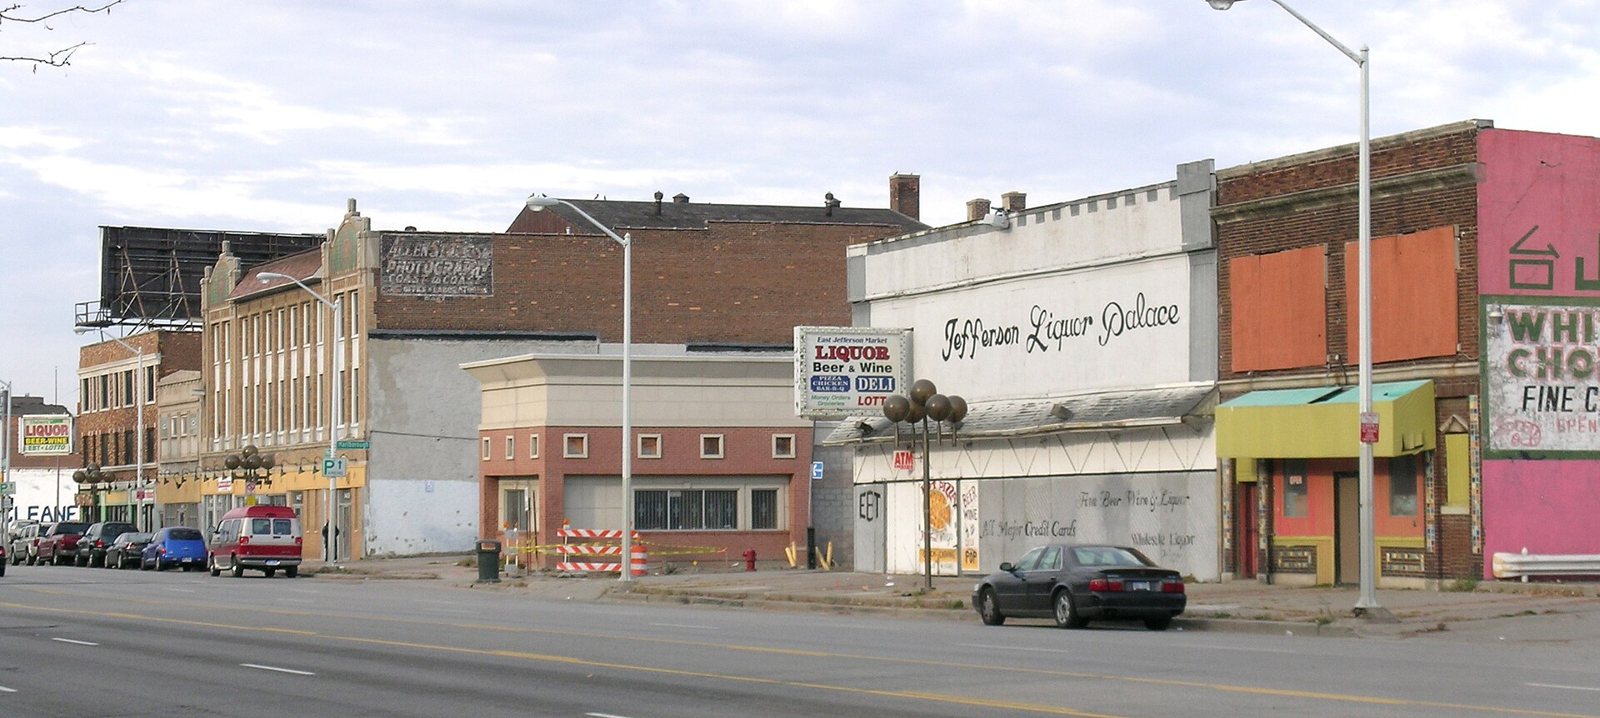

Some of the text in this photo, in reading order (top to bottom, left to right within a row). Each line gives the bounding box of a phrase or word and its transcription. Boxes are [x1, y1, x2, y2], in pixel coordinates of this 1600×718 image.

[942, 292, 1180, 362] Jefferson Liquor Palace
[817, 336, 888, 345] East Jefferson Market
[815, 345, 890, 363] LIQUOR
[813, 362, 893, 373] Beer & Wine
[1506, 346, 1600, 380] CHO
[858, 377, 894, 391] DELI
[858, 396, 888, 406] LOTT
[1522, 385, 1575, 413] FINE
[26, 424, 69, 436] LIQUOR
[894, 452, 914, 465] ATM
[324, 460, 335, 476] P
[962, 485, 977, 508] BEER
[9, 505, 80, 521] LEANE
[1024, 520, 1049, 536] Credit
[1051, 519, 1077, 537] Cards
